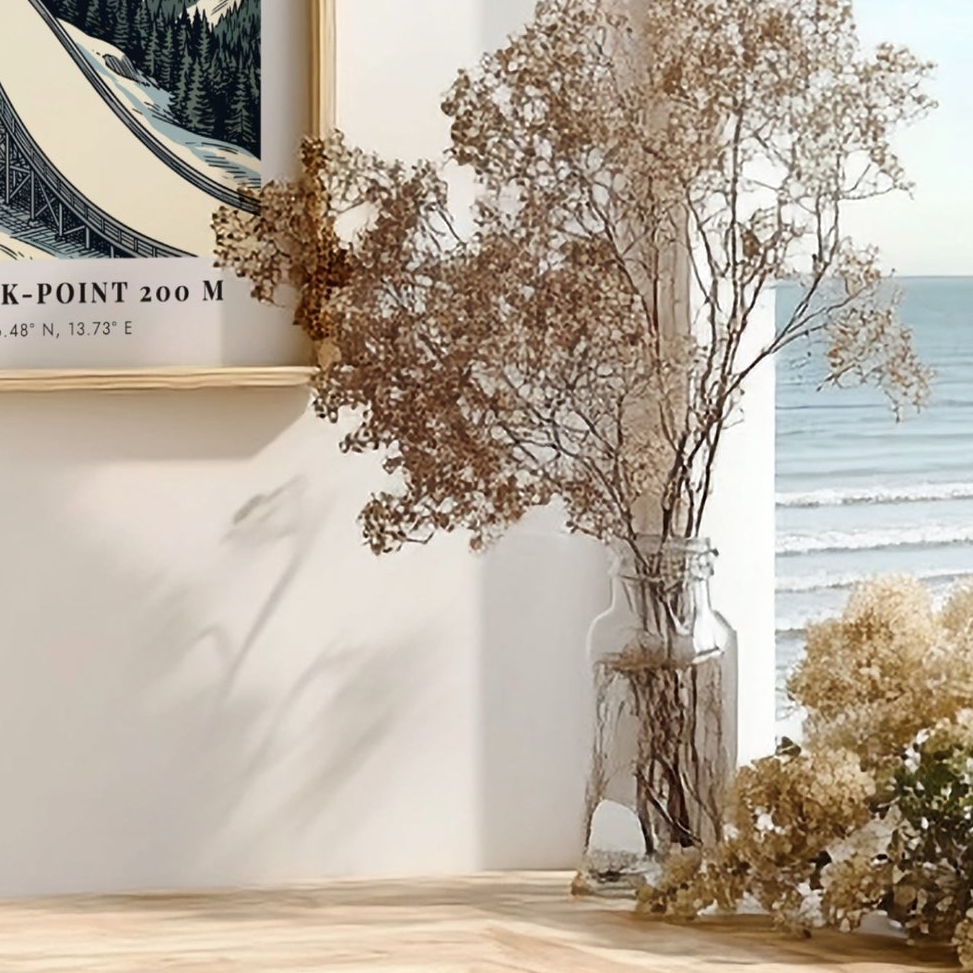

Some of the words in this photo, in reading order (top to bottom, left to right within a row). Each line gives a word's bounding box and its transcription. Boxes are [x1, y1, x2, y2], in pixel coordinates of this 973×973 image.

[1, 281, 129, 306] K-POINT
[140, 285, 190, 303] 200
[203, 280, 224, 301] M
[43, 322, 60, 339] N,
[69, 320, 117, 337] 13.73°
[124, 320, 133, 335] E
